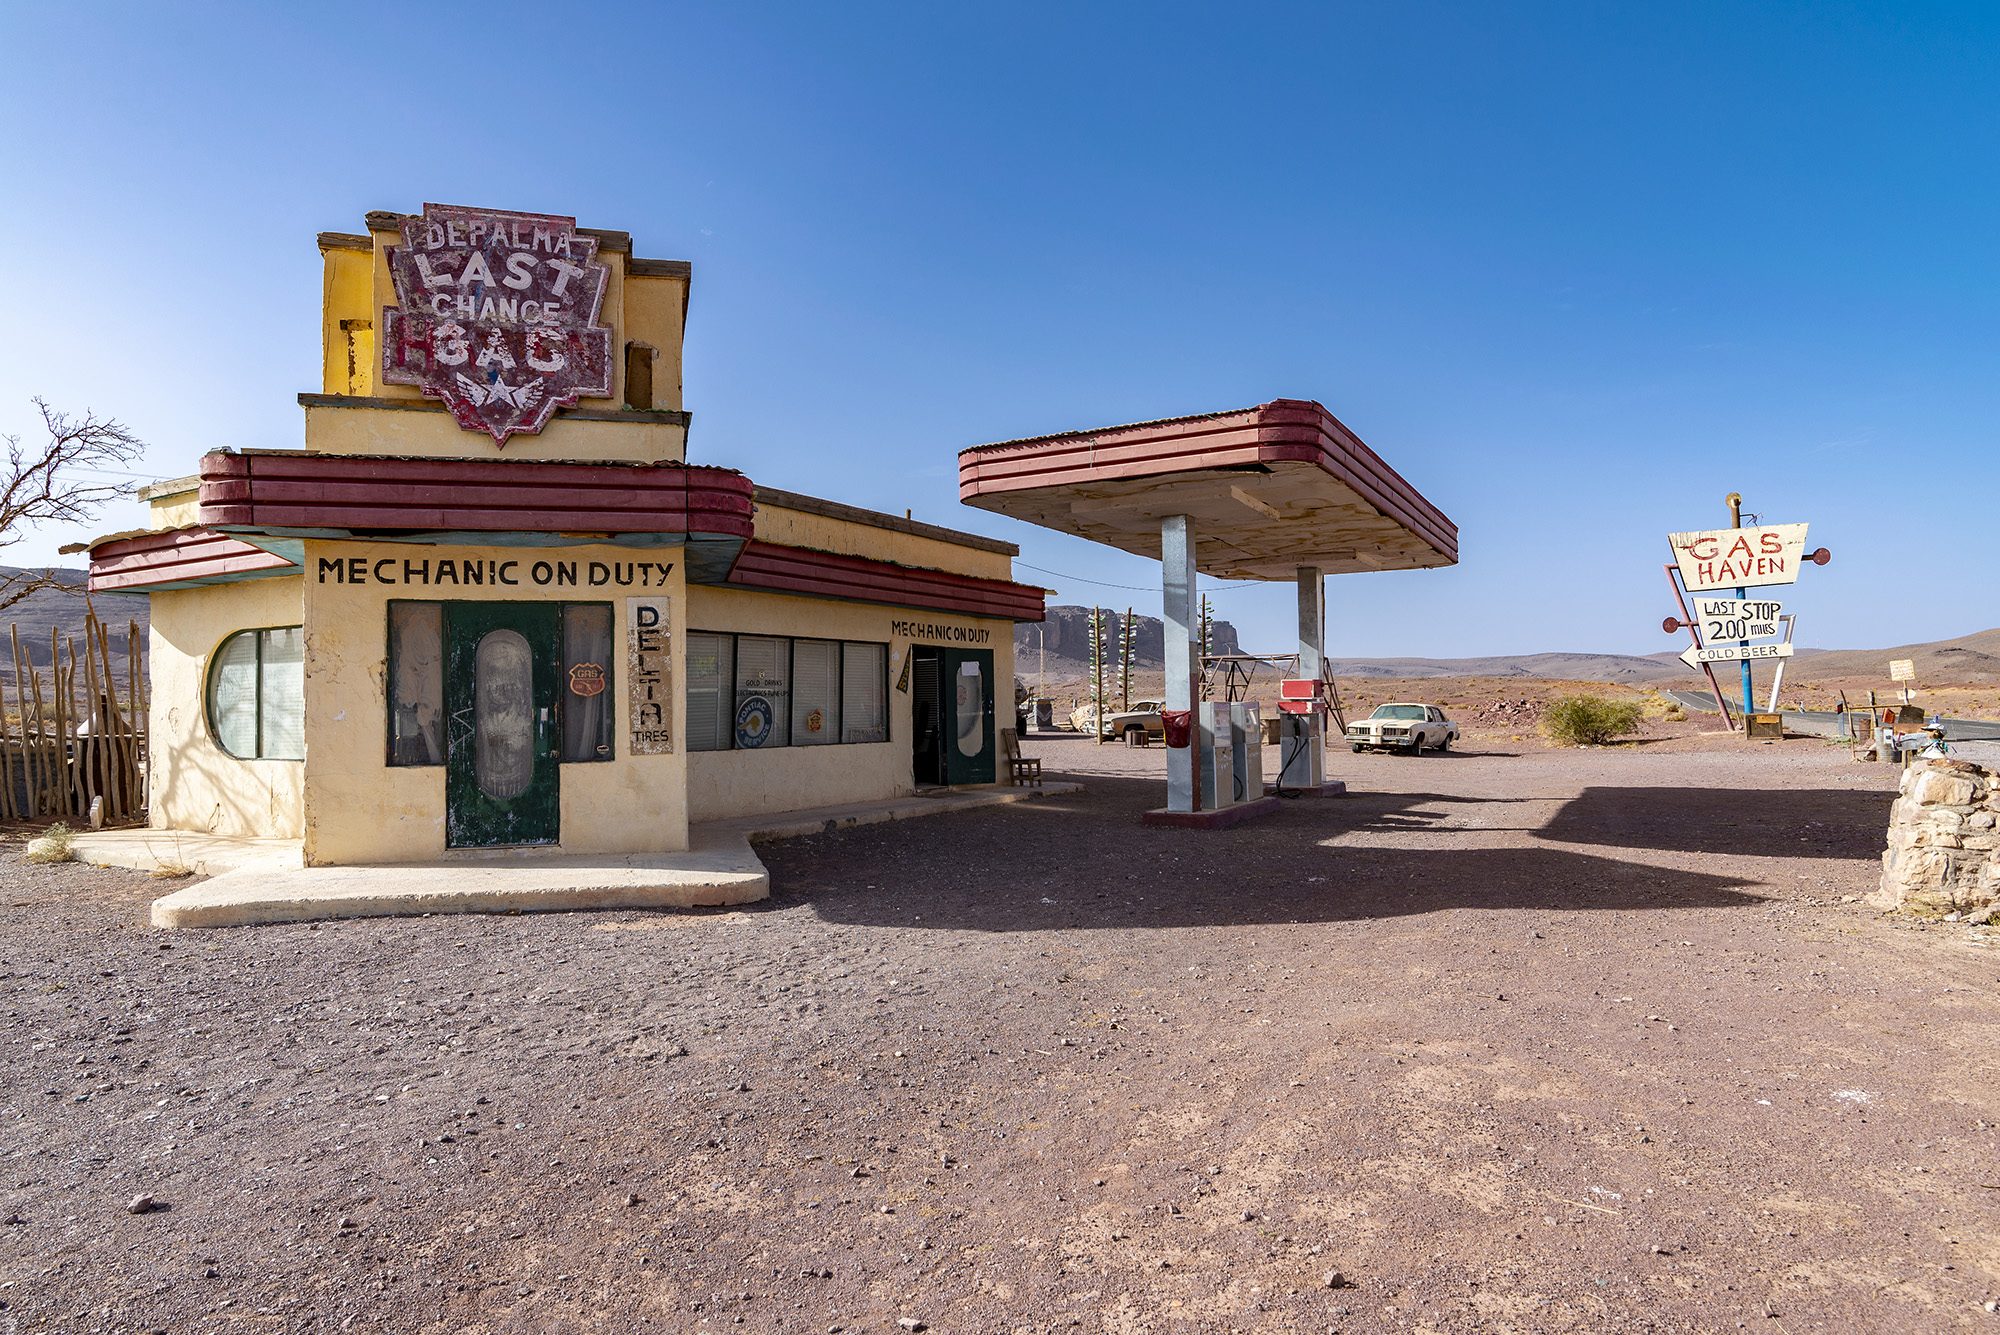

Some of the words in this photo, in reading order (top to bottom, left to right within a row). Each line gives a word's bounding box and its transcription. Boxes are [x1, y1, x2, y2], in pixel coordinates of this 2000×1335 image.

[427, 220, 572, 257] DEPALMA
[414, 250, 585, 297] LAST
[431, 293, 561, 326] CHANCE
[1683, 533, 1783, 560] GAS
[318, 558, 519, 585] MECHANIC
[531, 560, 577, 586] ON
[588, 562, 674, 587] DUTY
[1698, 557, 1785, 585] HAVEN
[1704, 602, 1737, 614] LAST
[1742, 602, 1781, 621] STOP
[892, 620, 952, 640] MECHANIC
[953, 627, 967, 642] ON
[968, 628, 990, 644] DUTY
[1708, 619, 1747, 640] 200
[637, 606, 662, 725] DELTA
[1697, 649, 1734, 661] COLD
[1741, 646, 1779, 657] BEER
[577, 669, 598, 678] GAS
[738, 701, 767, 724] PONTIAC
[632, 729, 669, 743] TIRES
[743, 724, 771, 746] SERVICE
